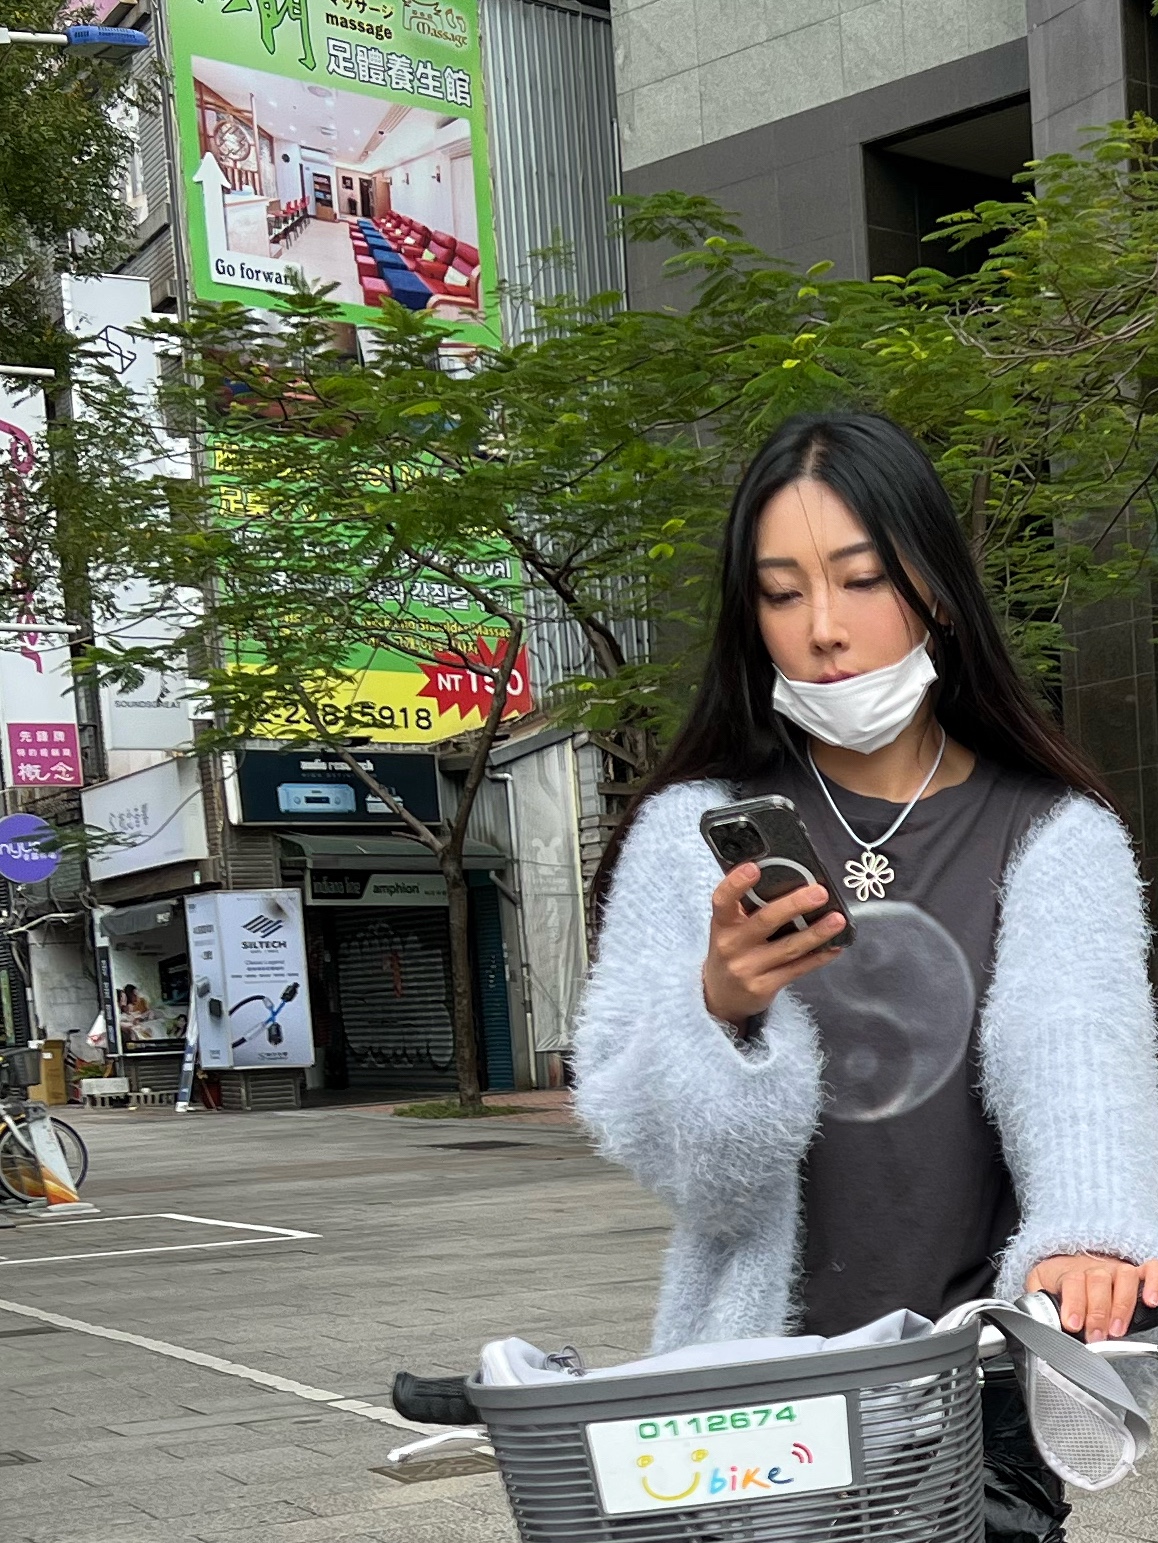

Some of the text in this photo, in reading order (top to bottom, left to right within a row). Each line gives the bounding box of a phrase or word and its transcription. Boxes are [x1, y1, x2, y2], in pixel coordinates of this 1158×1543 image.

[325, 12, 393, 41] massage
[416, 21, 468, 48] Massage
[326, 36, 472, 108] 足體養生館
[215, 258, 235, 277] Go
[437, 672, 463, 692] NT
[241, 940, 288, 950] SILTECH
[637, 1404, 797, 1441] 0112674
